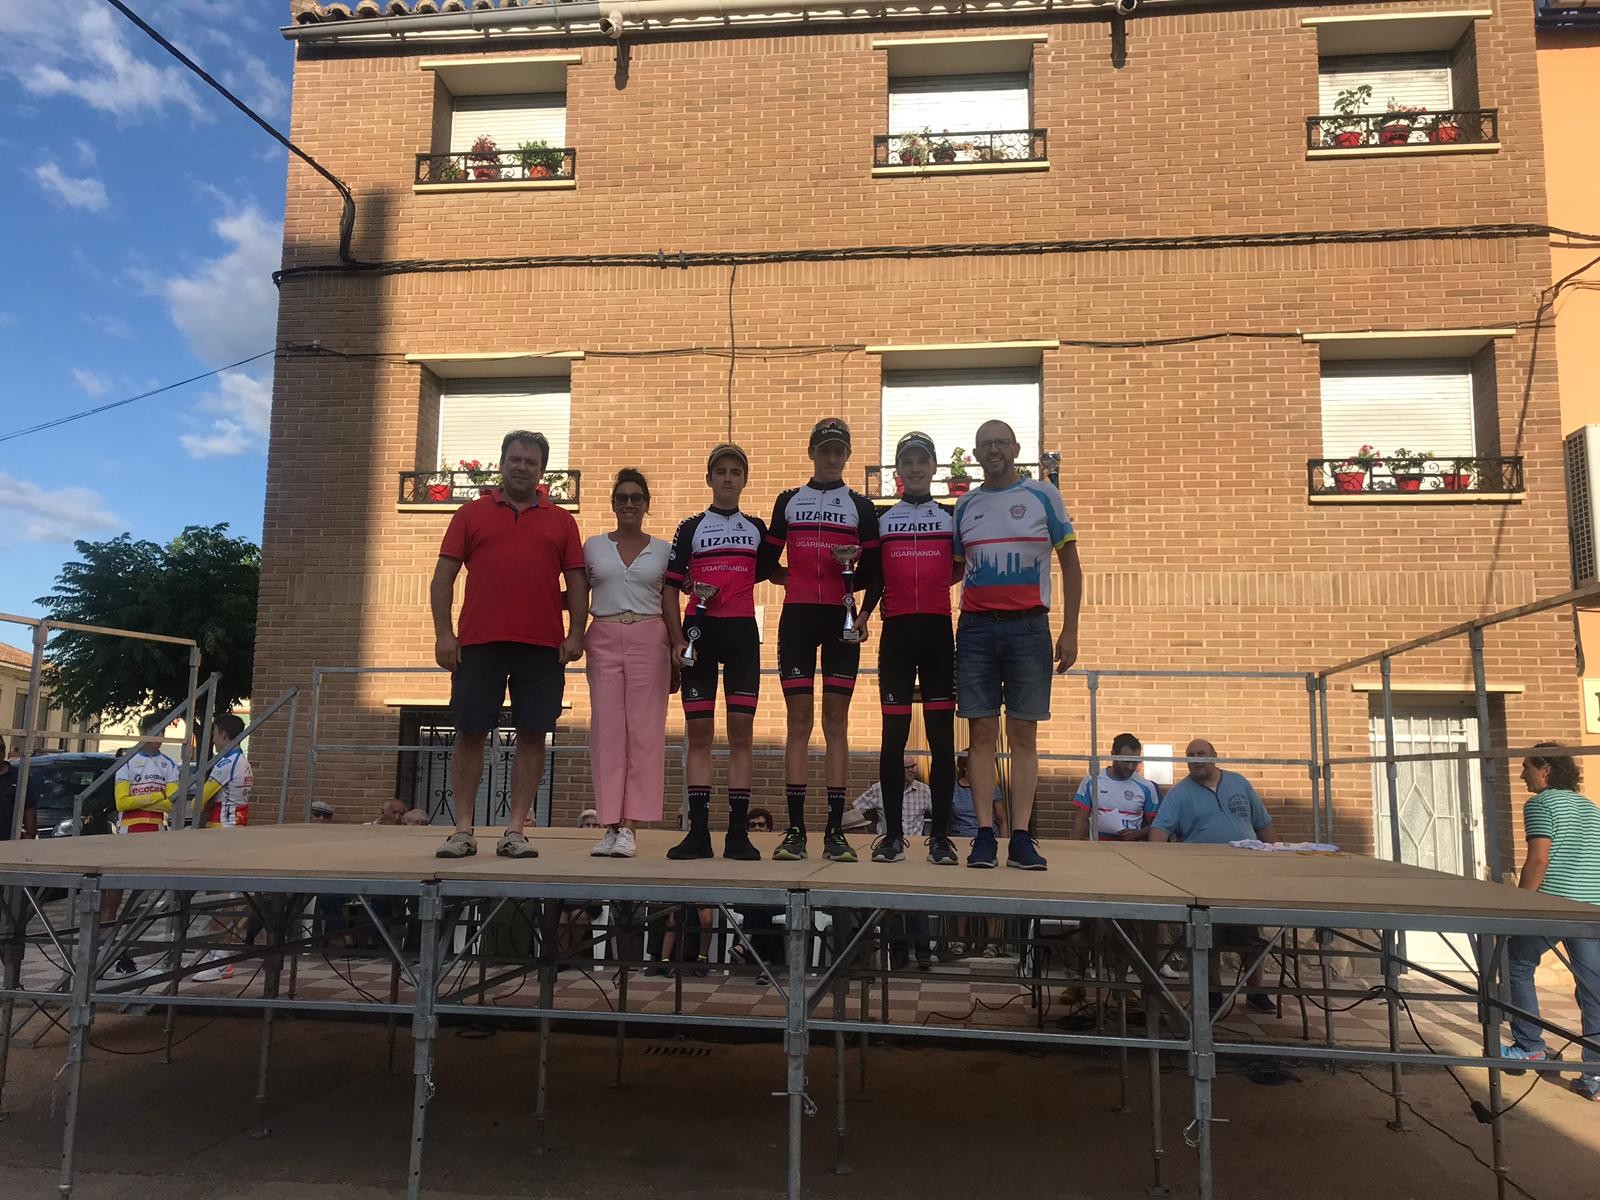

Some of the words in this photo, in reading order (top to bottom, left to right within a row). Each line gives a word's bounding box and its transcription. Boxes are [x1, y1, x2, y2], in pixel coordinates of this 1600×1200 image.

[796, 511, 847, 524] LIZARTE
[888, 522, 943, 533] LIZARTE
[700, 536, 755, 548] LIZARTE
[890, 549, 941, 558] UGARRANDIA
